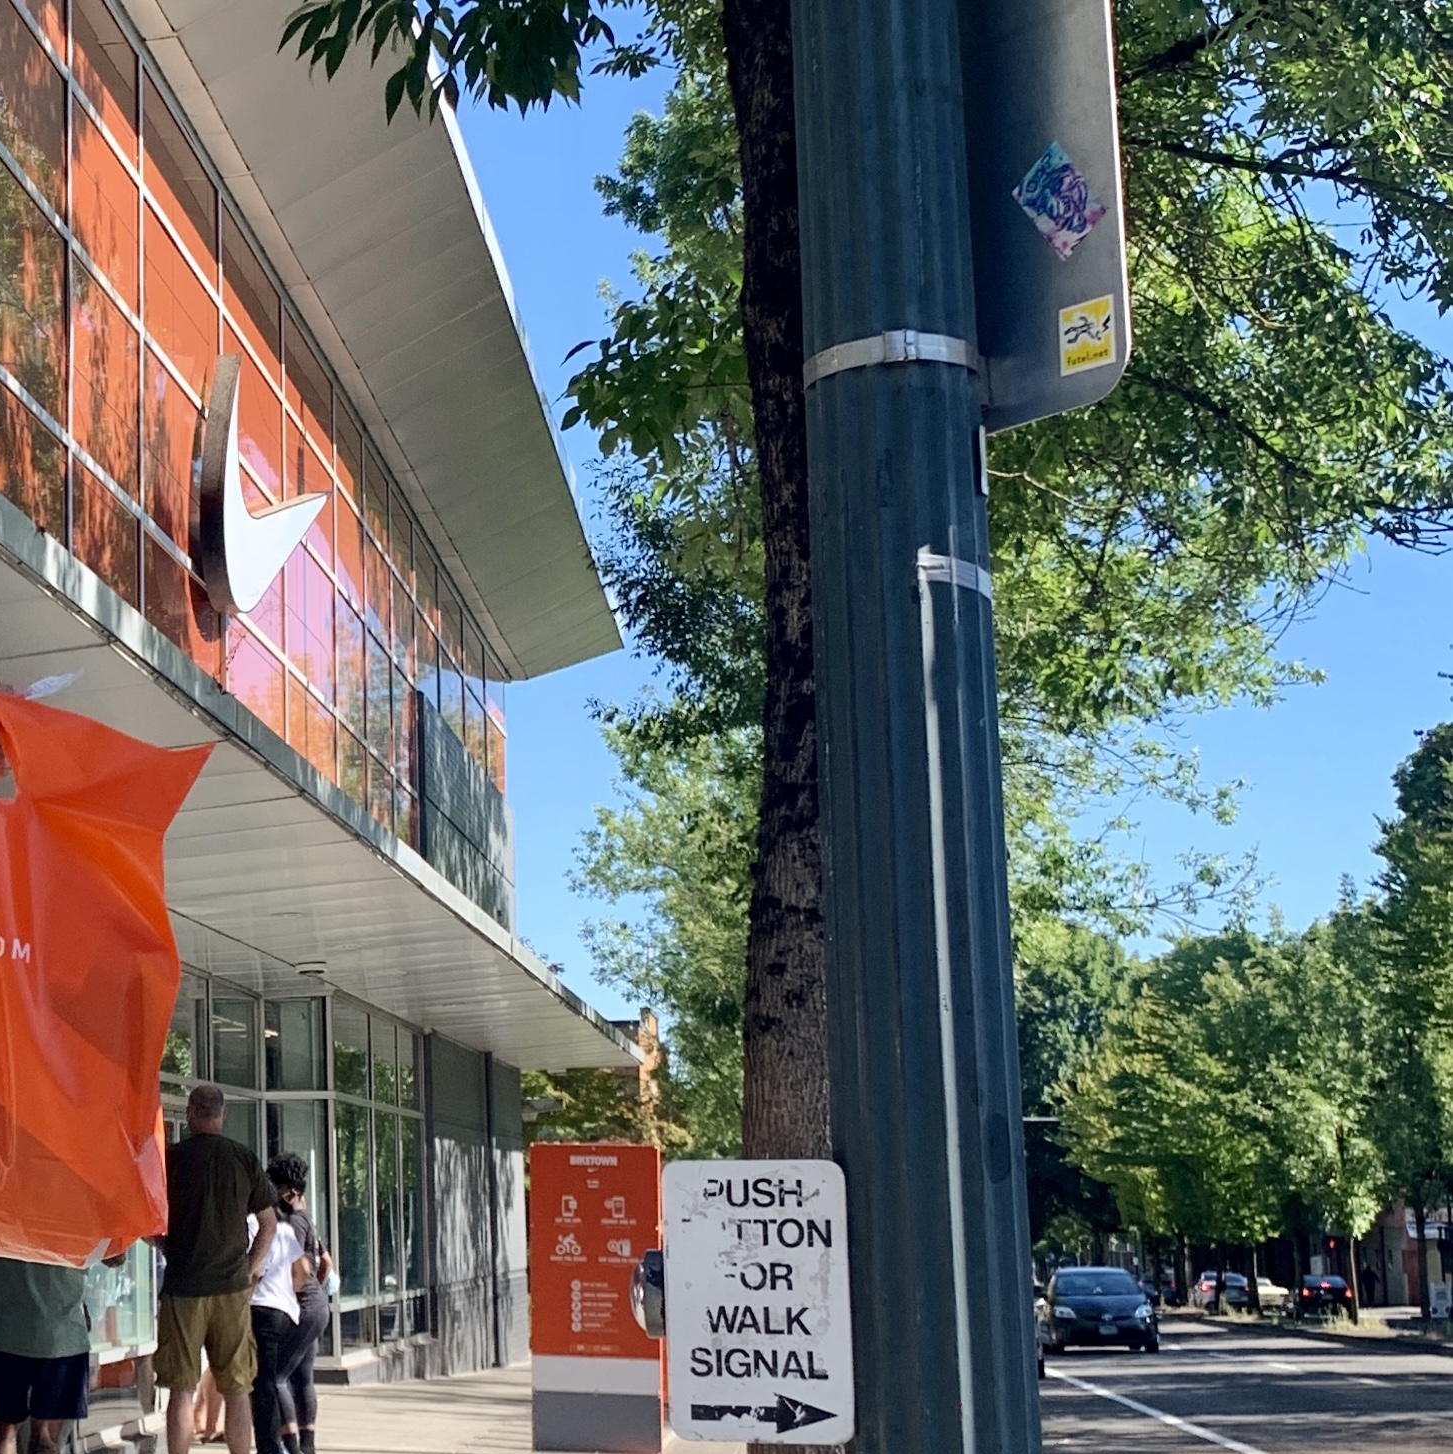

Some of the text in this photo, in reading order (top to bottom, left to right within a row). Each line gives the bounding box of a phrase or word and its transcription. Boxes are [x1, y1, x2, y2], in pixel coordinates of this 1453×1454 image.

[1067, 348, 1109, 366] futel.net
[703, 1178, 803, 1208] PUSH
[682, 1218, 833, 1248] TTON
[724, 1262, 794, 1292] OR
[706, 1305, 812, 1336] WALK
[689, 1347, 829, 1380] SIGNAL
